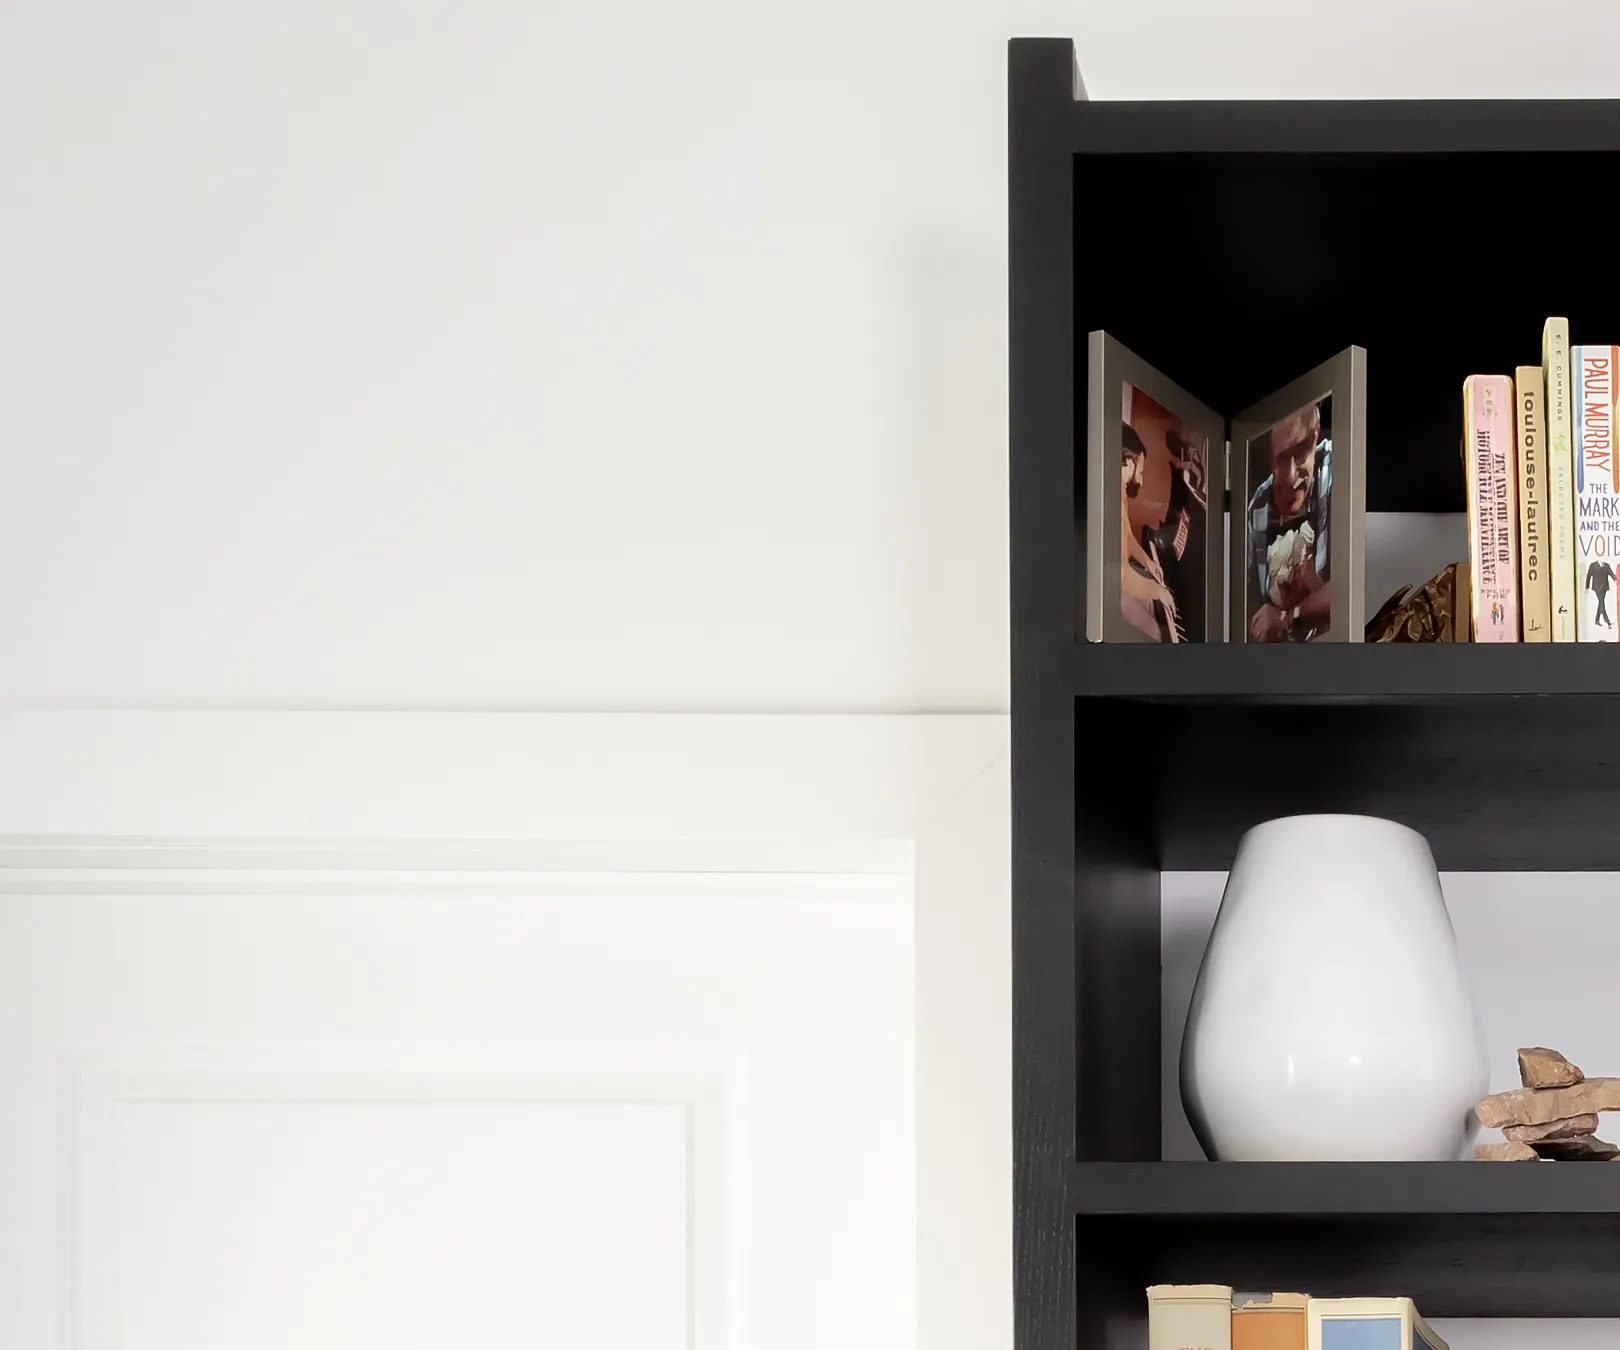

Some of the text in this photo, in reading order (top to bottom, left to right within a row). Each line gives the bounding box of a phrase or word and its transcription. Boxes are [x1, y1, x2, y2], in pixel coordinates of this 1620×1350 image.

[1524, 392, 1539, 581] toulouse-lautrec
[1582, 358, 1609, 471] PAUL MURRAY
